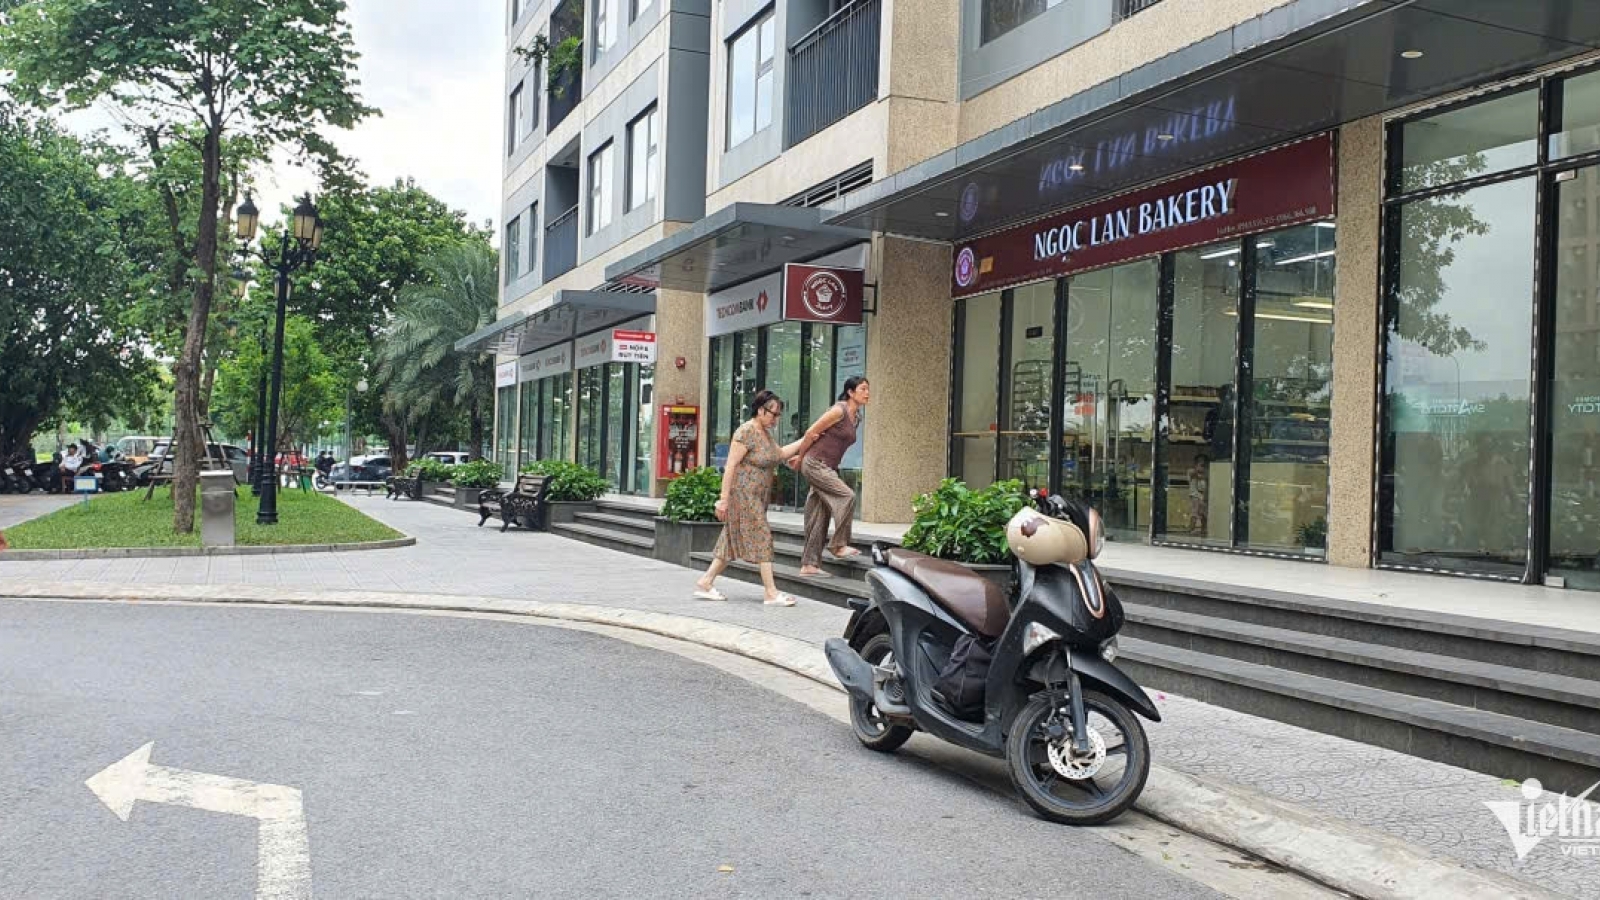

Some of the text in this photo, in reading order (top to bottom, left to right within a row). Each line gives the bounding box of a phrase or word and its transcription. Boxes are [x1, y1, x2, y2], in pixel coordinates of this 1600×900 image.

[1034, 220, 1084, 262] NGỌC
[1090, 207, 1131, 246] LAN
[1138, 178, 1234, 235] BAKERY
